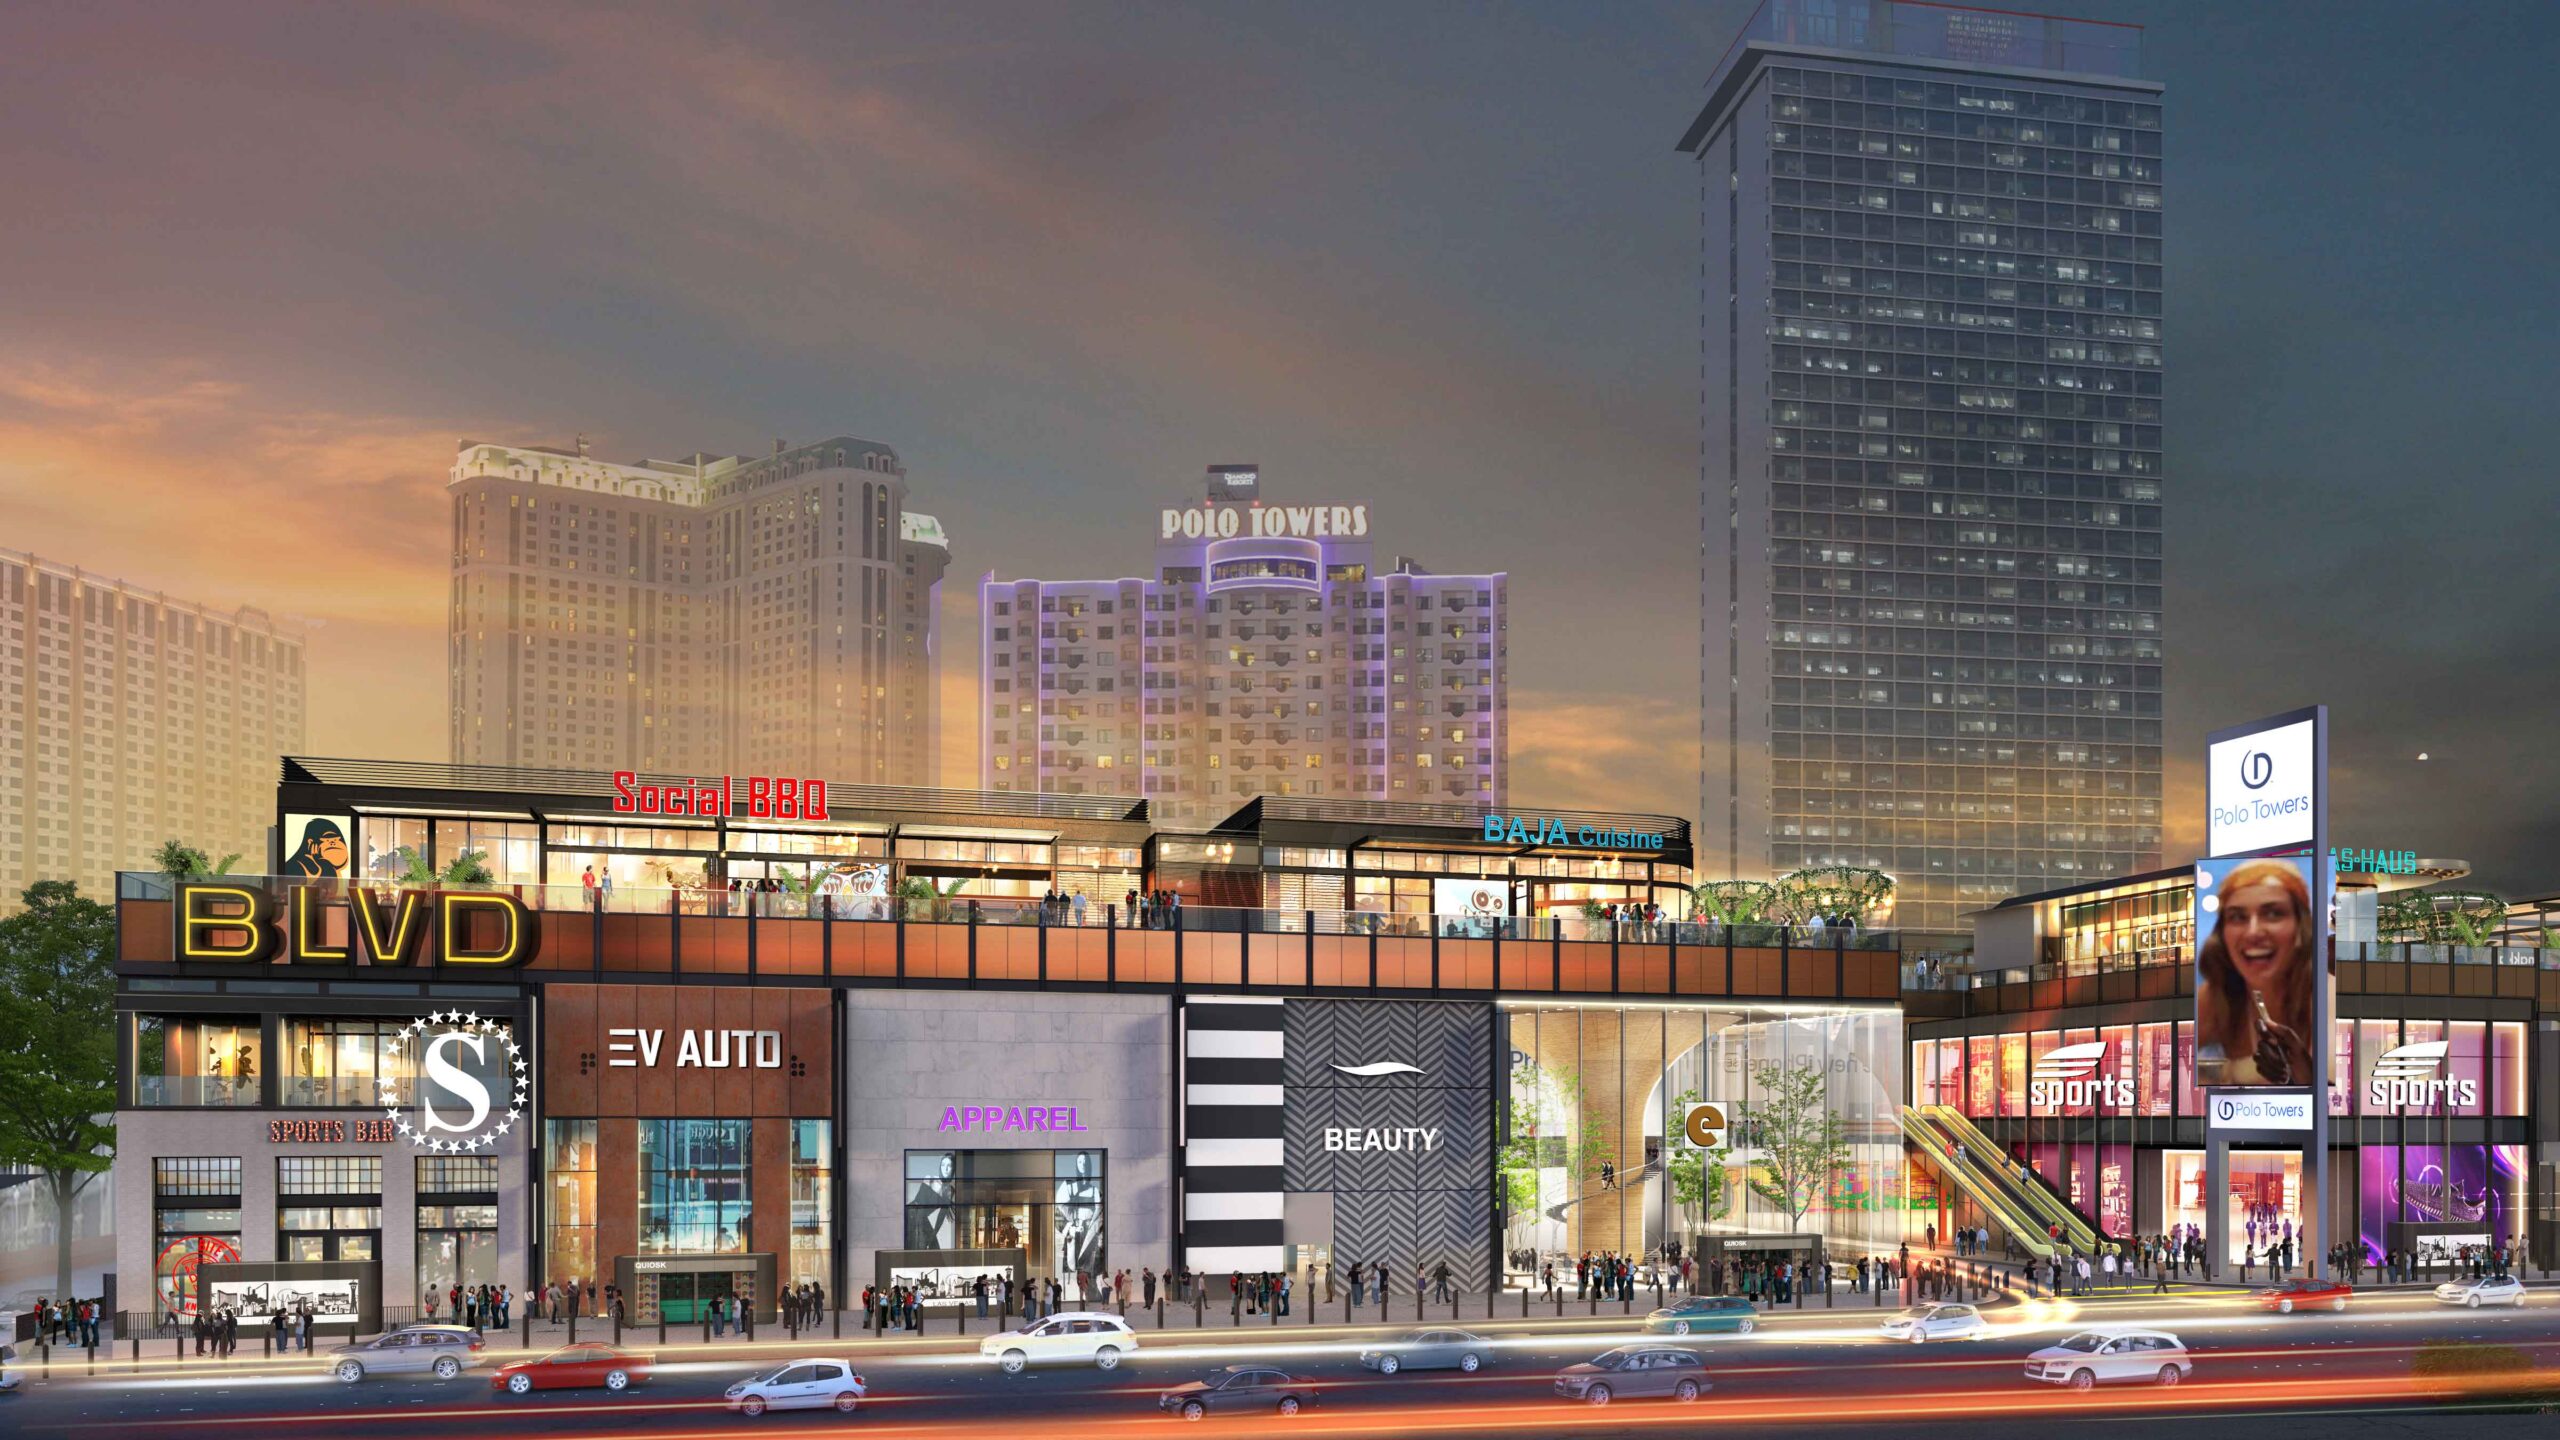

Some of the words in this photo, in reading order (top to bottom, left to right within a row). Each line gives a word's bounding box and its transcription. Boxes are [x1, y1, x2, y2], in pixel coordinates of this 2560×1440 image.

[1162, 507, 1240, 539] POLO
[1249, 505, 1369, 537] TOWERS
[613, 770, 733, 817] Social
[748, 776, 830, 821] BBQ
[2214, 804, 2249, 828] Polo
[2251, 796, 2309, 820] Towers
[1484, 815, 1570, 845] BAJA
[1578, 825, 1665, 850] Cuisine
[176, 884, 532, 966] BLVD
[609, 1029, 664, 1067] EV
[676, 1030, 782, 1069] AUTO
[2030, 1073, 2136, 1114] sports
[2236, 1102, 2261, 1117] Polo
[2262, 1101, 2304, 1118] Towers
[2370, 1074, 2476, 1114] sports
[269, 1120, 344, 1143] SPORTS
[355, 1120, 394, 1143] BAR
[938, 1106, 1089, 1132] APPAREL
[1324, 1128, 1438, 1151] BEAUTY
[635, 1261, 667, 1269] QUIOSK
